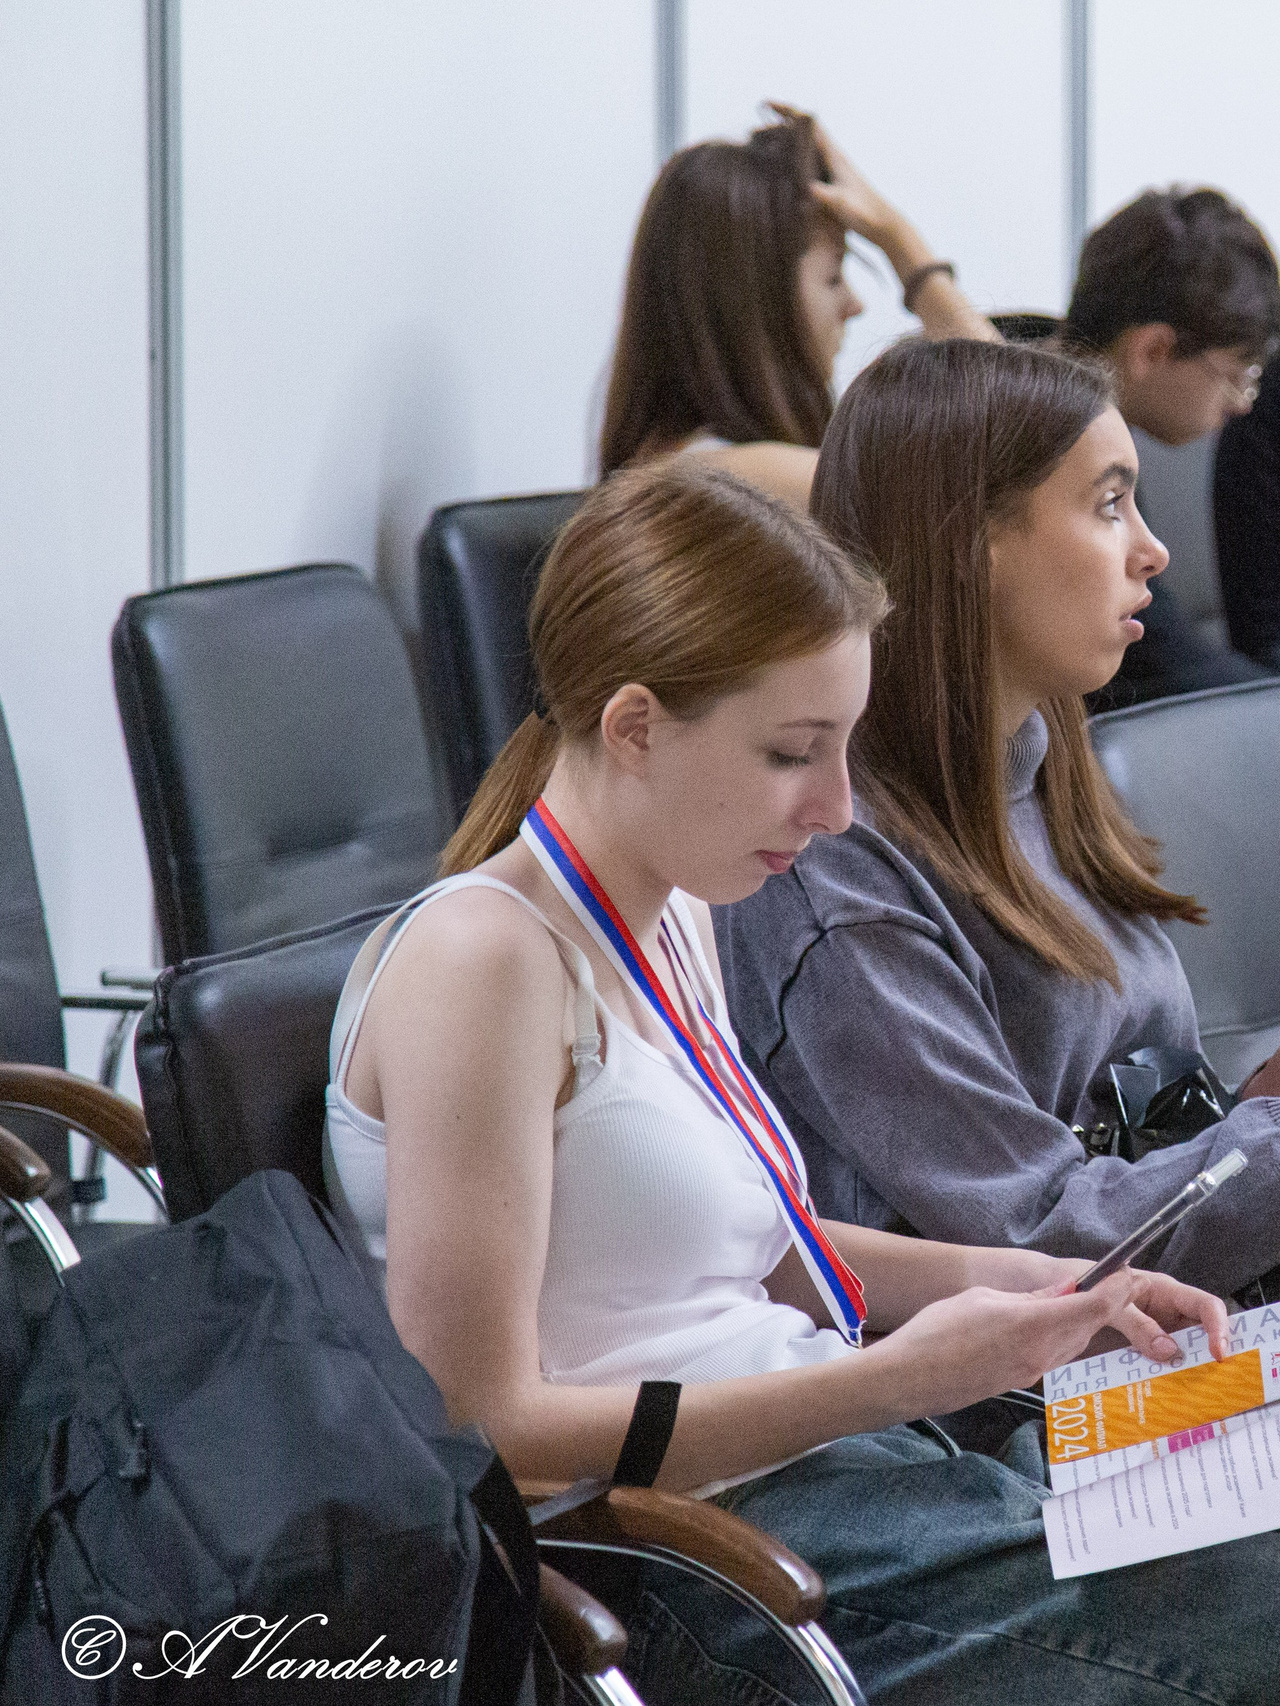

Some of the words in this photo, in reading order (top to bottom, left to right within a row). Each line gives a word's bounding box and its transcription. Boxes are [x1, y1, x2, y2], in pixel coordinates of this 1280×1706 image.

[1050, 1376, 1108, 1403] ДЛЯ
[1091, 1391, 1104, 1421] ОМСКИЙ
[1051, 1397, 1090, 1460] 2024
[1094, 1419, 1107, 1450] ФИЛИАЛ
